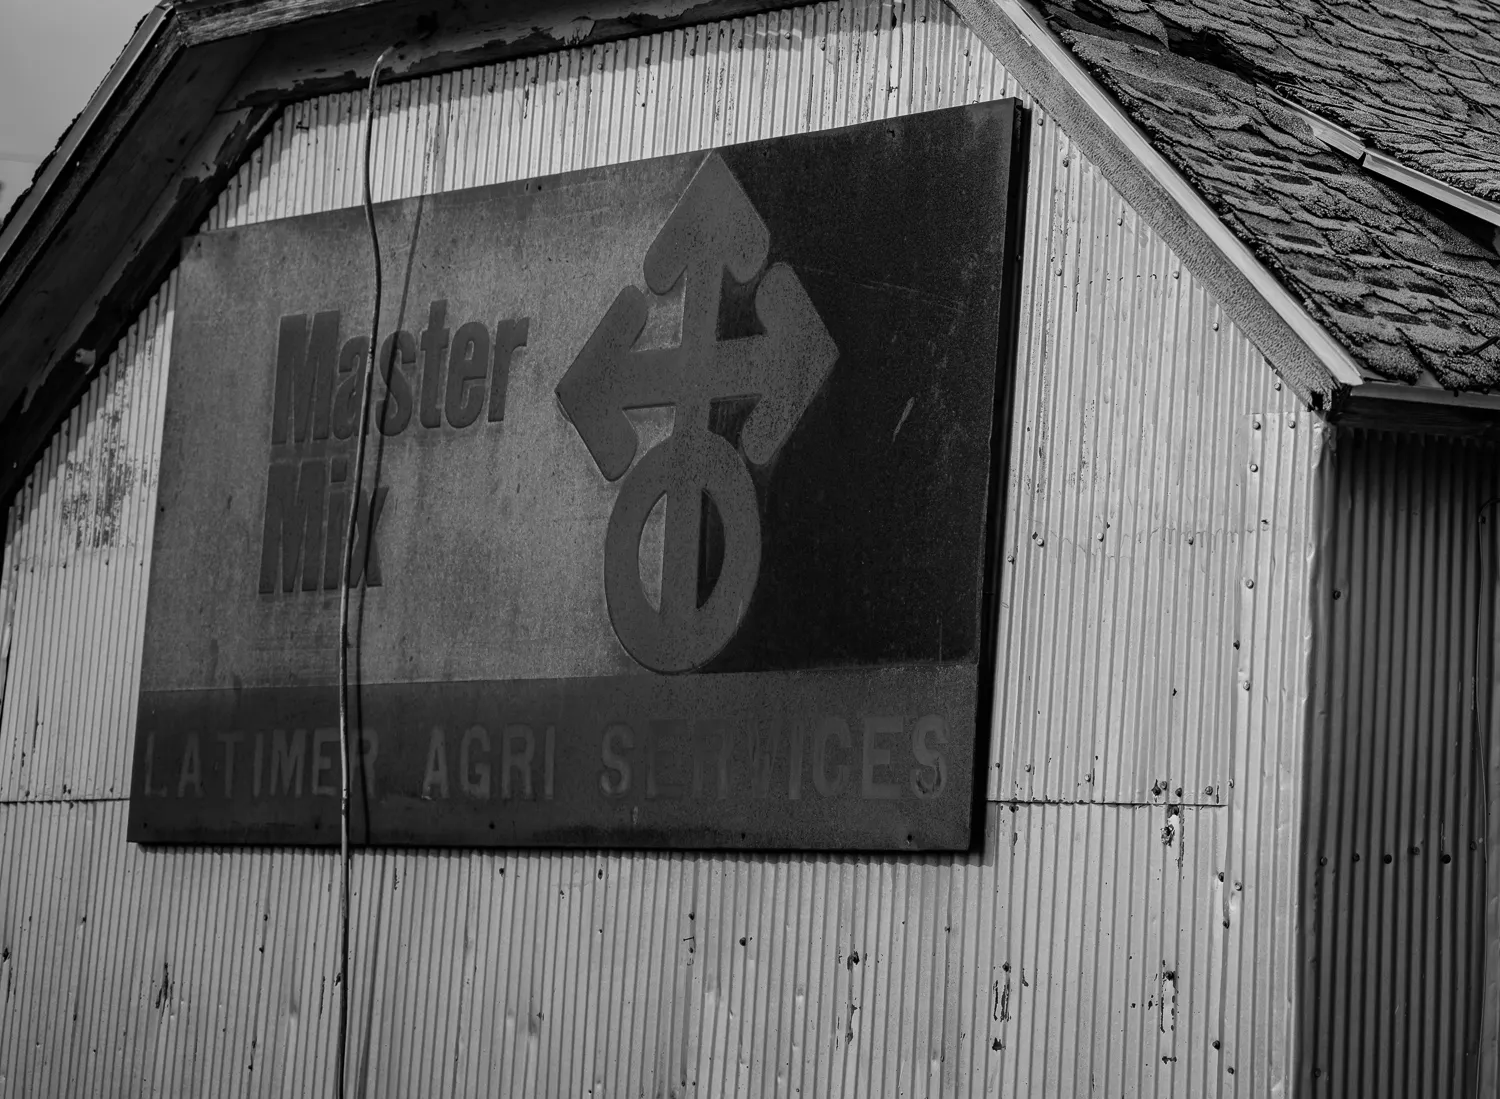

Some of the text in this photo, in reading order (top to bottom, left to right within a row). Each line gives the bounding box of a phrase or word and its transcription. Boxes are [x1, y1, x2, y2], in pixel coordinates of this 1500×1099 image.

[272, 300, 531, 444] Master
[258, 459, 389, 594] Mix
[143, 714, 951, 801] LATIMER AGRI SERVICES
